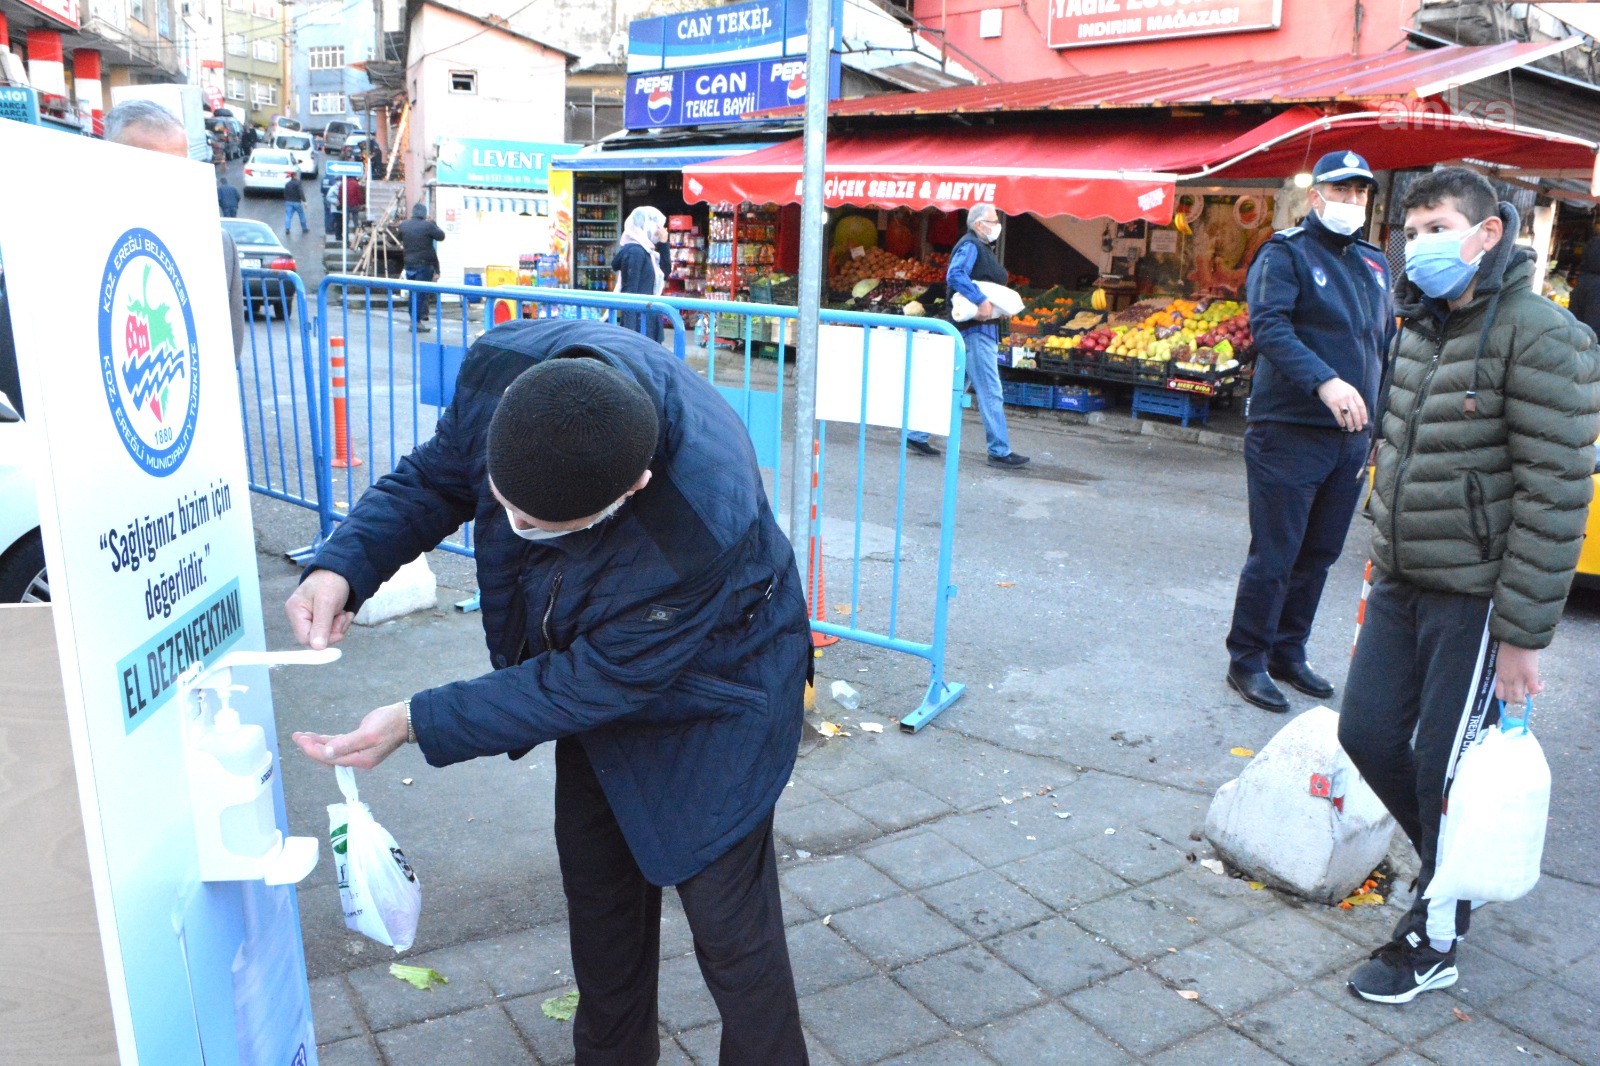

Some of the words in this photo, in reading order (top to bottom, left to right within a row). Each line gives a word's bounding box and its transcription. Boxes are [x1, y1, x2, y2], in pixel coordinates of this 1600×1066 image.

[678, 16, 713, 39] CAN
[717, 7, 772, 35] TEKEL
[1147, 7, 1239, 31] MAĞAZASI
[771, 61, 807, 82] PEPS
[635, 75, 674, 94] PEPSI
[695, 72, 747, 95] CAN
[686, 99, 720, 118] TEKEL
[472, 148, 545, 170] LEVENT
[868, 180, 916, 199] SEBZE
[919, 181, 932, 199] &
[936, 181, 997, 202] MEYVE
[103, 272, 117, 313] KDZ.
[113, 233, 142, 271] EREĞLİ
[144, 238, 188, 307] BELEDİYESİ
[103, 355, 116, 403] KDZ.
[115, 406, 145, 460] EREĞLİ
[146, 418, 192, 469] MUNICIPALITY
[189, 342, 198, 416] TÜRKİYE
[154, 427, 173, 445] 1880
[177, 490, 210, 535] bizim
[210, 478, 231, 520] için
[123, 664, 147, 719] EL
[146, 589, 241, 700] DEZENFEKTANI
[1465, 714, 1482, 740] TREND
